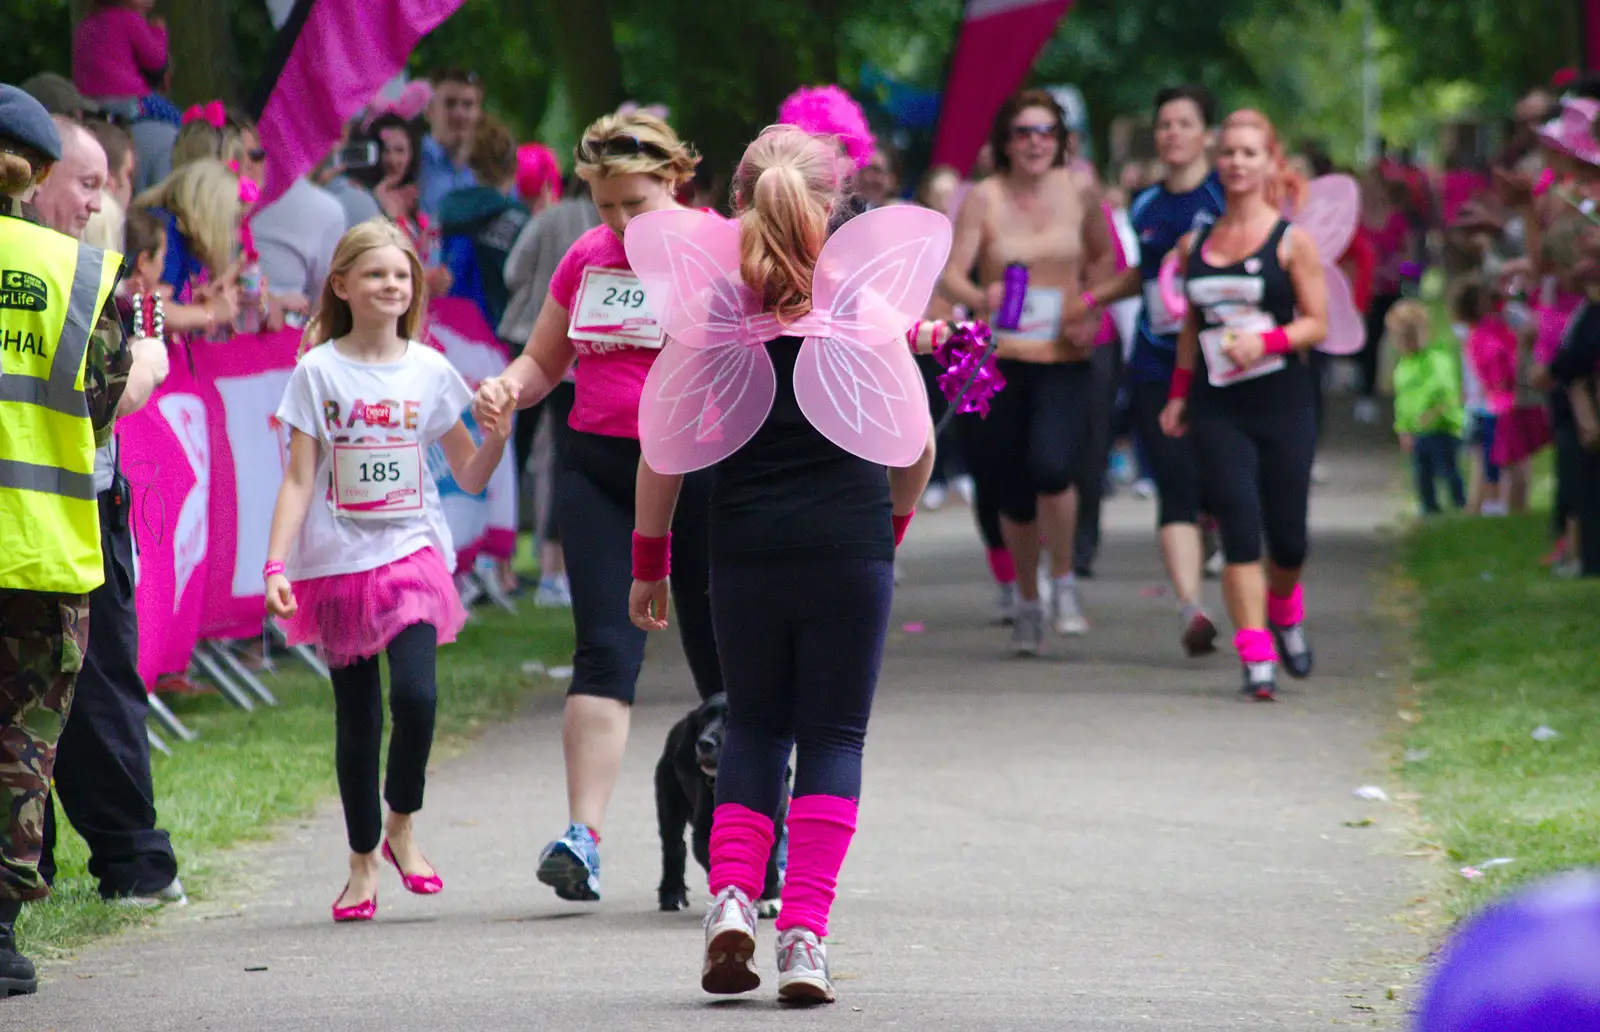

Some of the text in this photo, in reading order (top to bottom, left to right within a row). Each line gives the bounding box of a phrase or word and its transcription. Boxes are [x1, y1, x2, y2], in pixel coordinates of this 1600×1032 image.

[11, 292, 35, 306] Life
[602, 287, 645, 308] 249
[0, 328, 48, 359] HAL
[322, 398, 421, 431] RACE
[359, 461, 401, 482] 185
